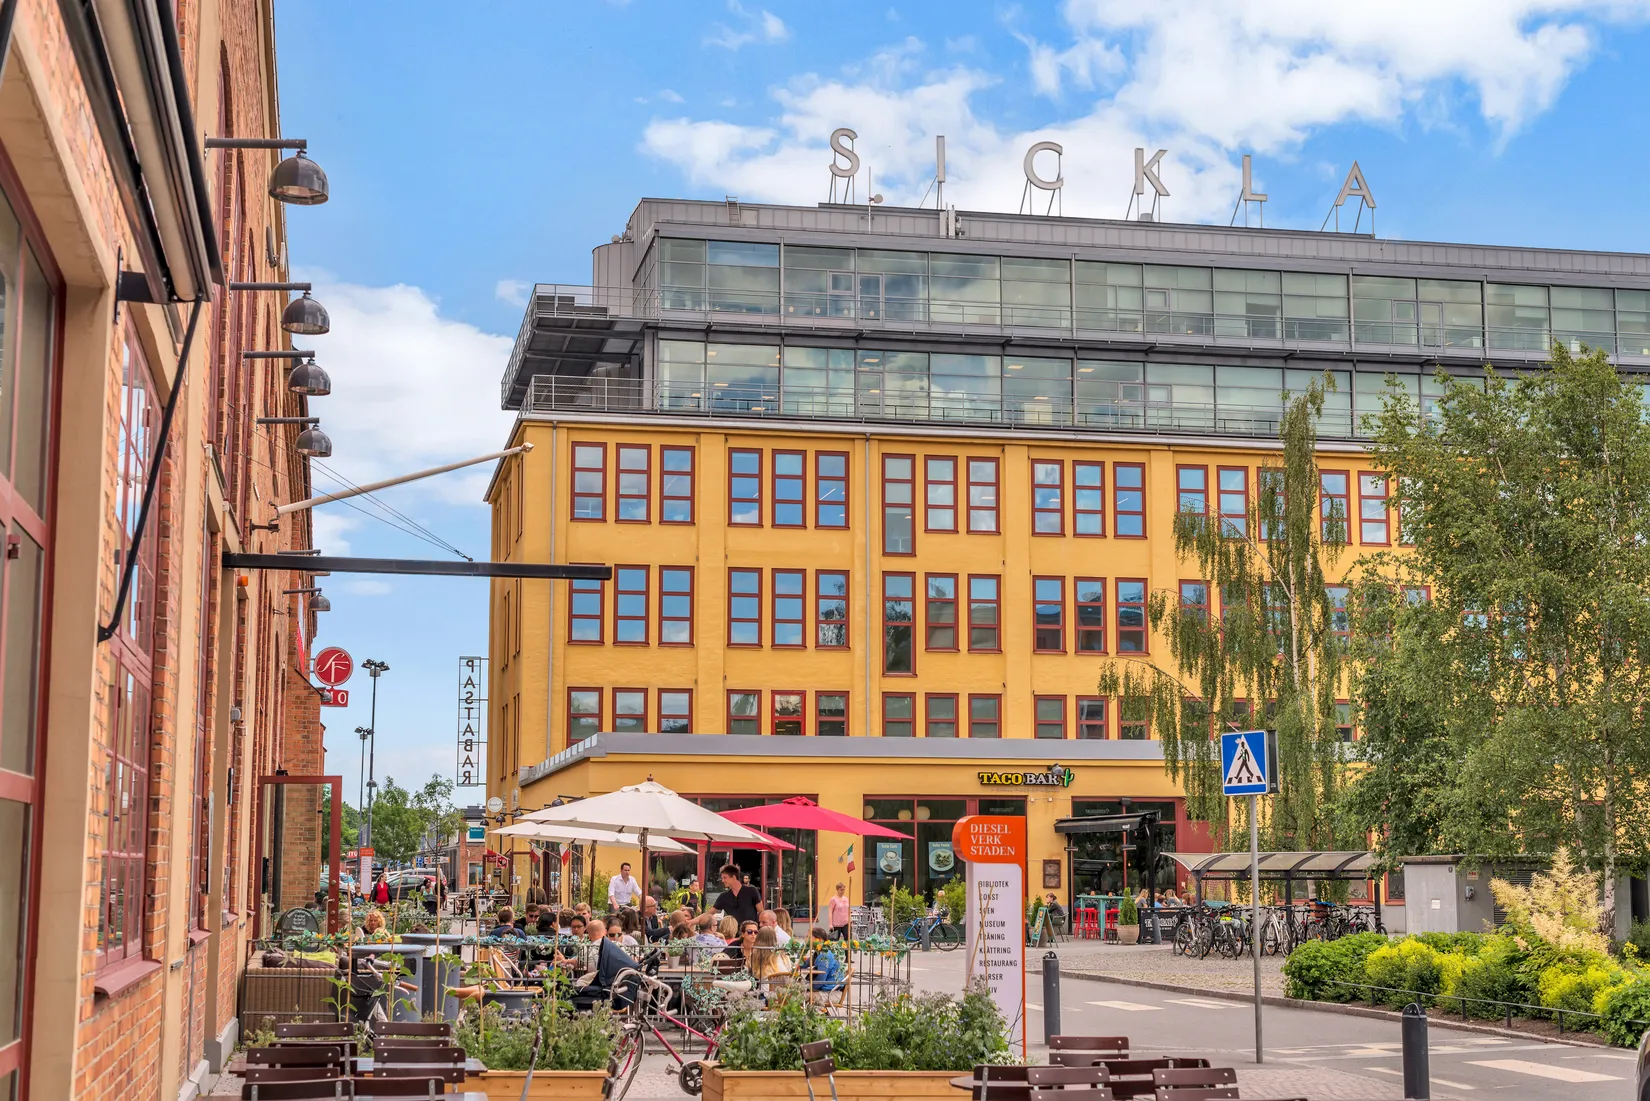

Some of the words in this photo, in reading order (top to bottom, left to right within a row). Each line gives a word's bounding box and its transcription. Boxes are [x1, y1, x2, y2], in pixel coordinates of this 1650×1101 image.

[829, 128, 1377, 208] SICKLA
[978, 772, 1023, 785] TACO
[1025, 772, 1060, 785] BAR
[970, 823, 1011, 834] DIESEL
[970, 834, 1002, 845] VERK
[970, 845, 1016, 856] STADEN
[979, 946, 1012, 954] KÄTTRING
